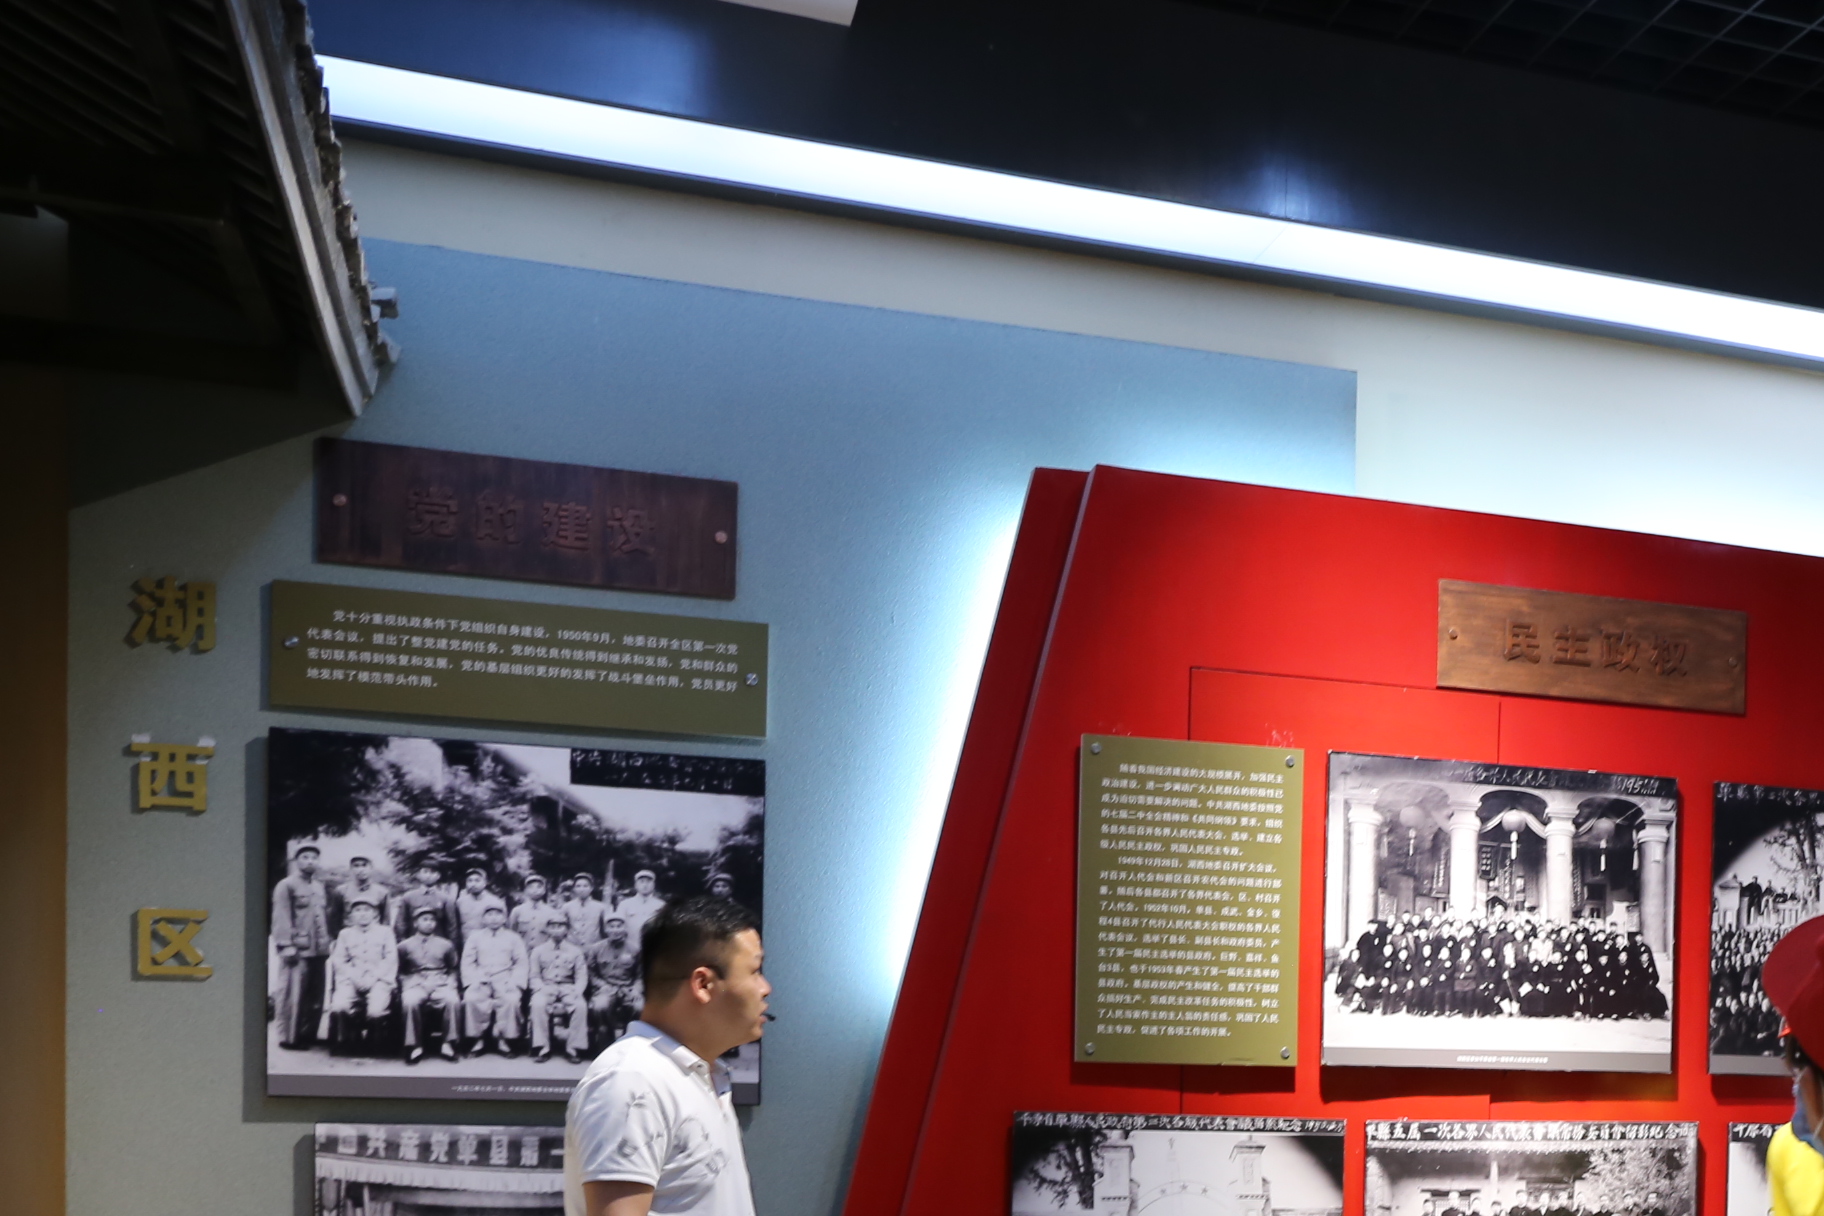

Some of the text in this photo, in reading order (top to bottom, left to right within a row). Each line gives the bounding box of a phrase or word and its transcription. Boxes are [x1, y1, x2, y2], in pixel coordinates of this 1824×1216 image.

[405, 482, 657, 557] 党的建设
[1502, 617, 1688, 678] 民主政权
[130, 575, 217, 979] 湖西区
